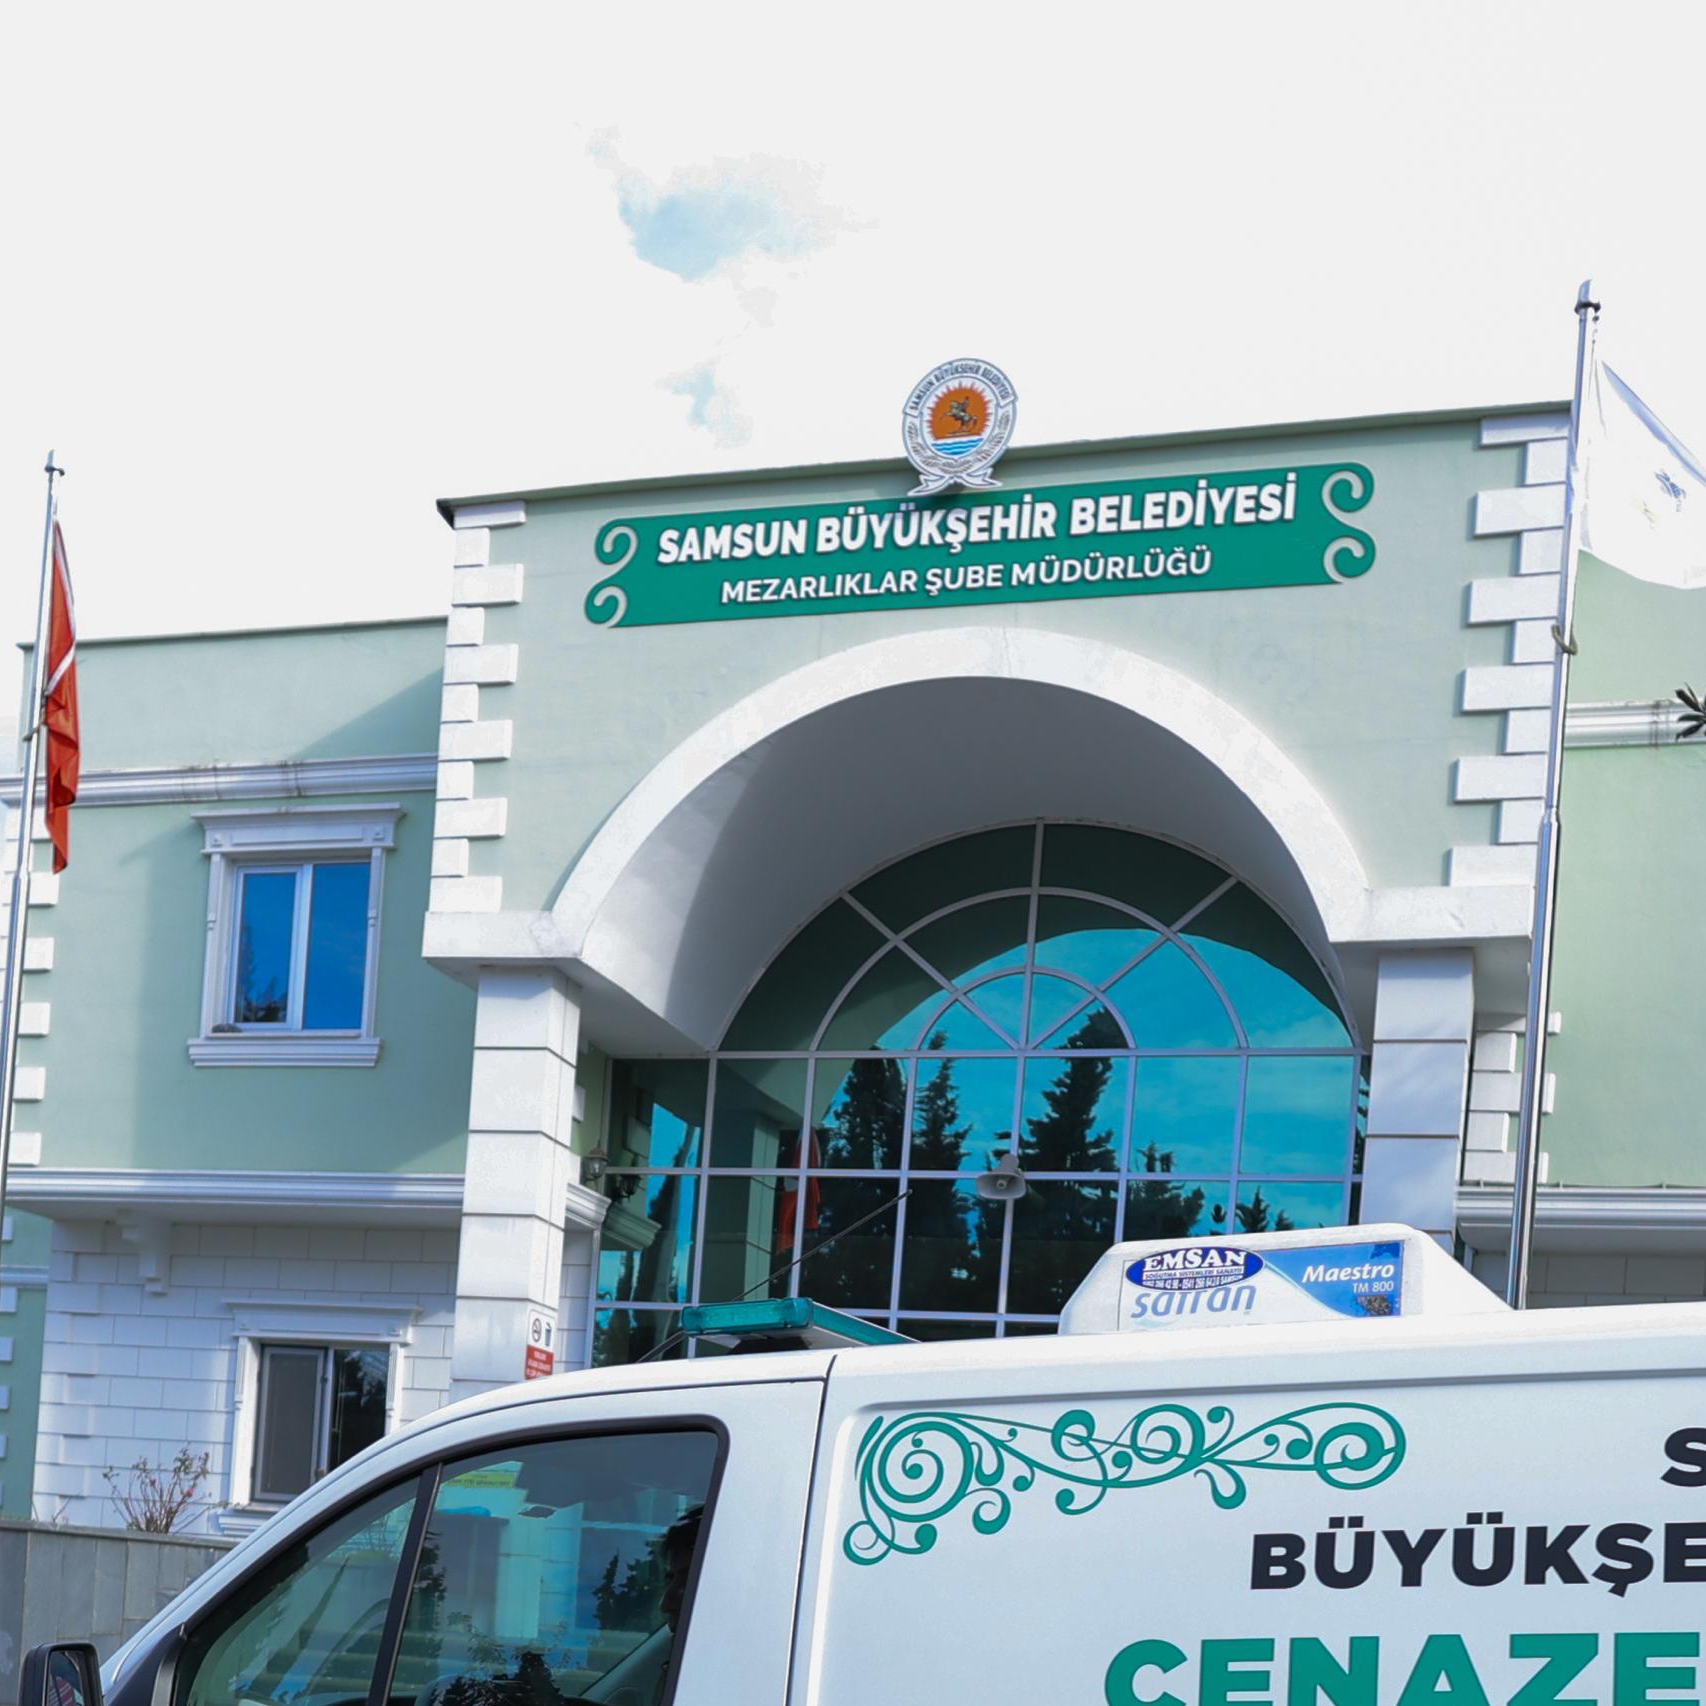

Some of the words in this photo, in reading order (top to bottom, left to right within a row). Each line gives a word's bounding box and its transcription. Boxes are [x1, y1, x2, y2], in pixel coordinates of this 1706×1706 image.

[657, 518, 809, 564] SAMSUN
[815, 493, 1057, 554] BÜYÜKŞEHİR
[1069, 471, 1297, 536] BELEDİYESİ
[720, 569, 918, 603] MEZARLIKLAR
[924, 563, 1004, 597] ŞUBE
[1010, 544, 1212, 587] MÜDÜRLÜĞÜ
[1143, 1248, 1247, 1272] EMSAN
[1301, 1263, 1395, 1283] Maestro
[1353, 1282, 1369, 1294] TM
[1372, 1281, 1394, 1293] 800
